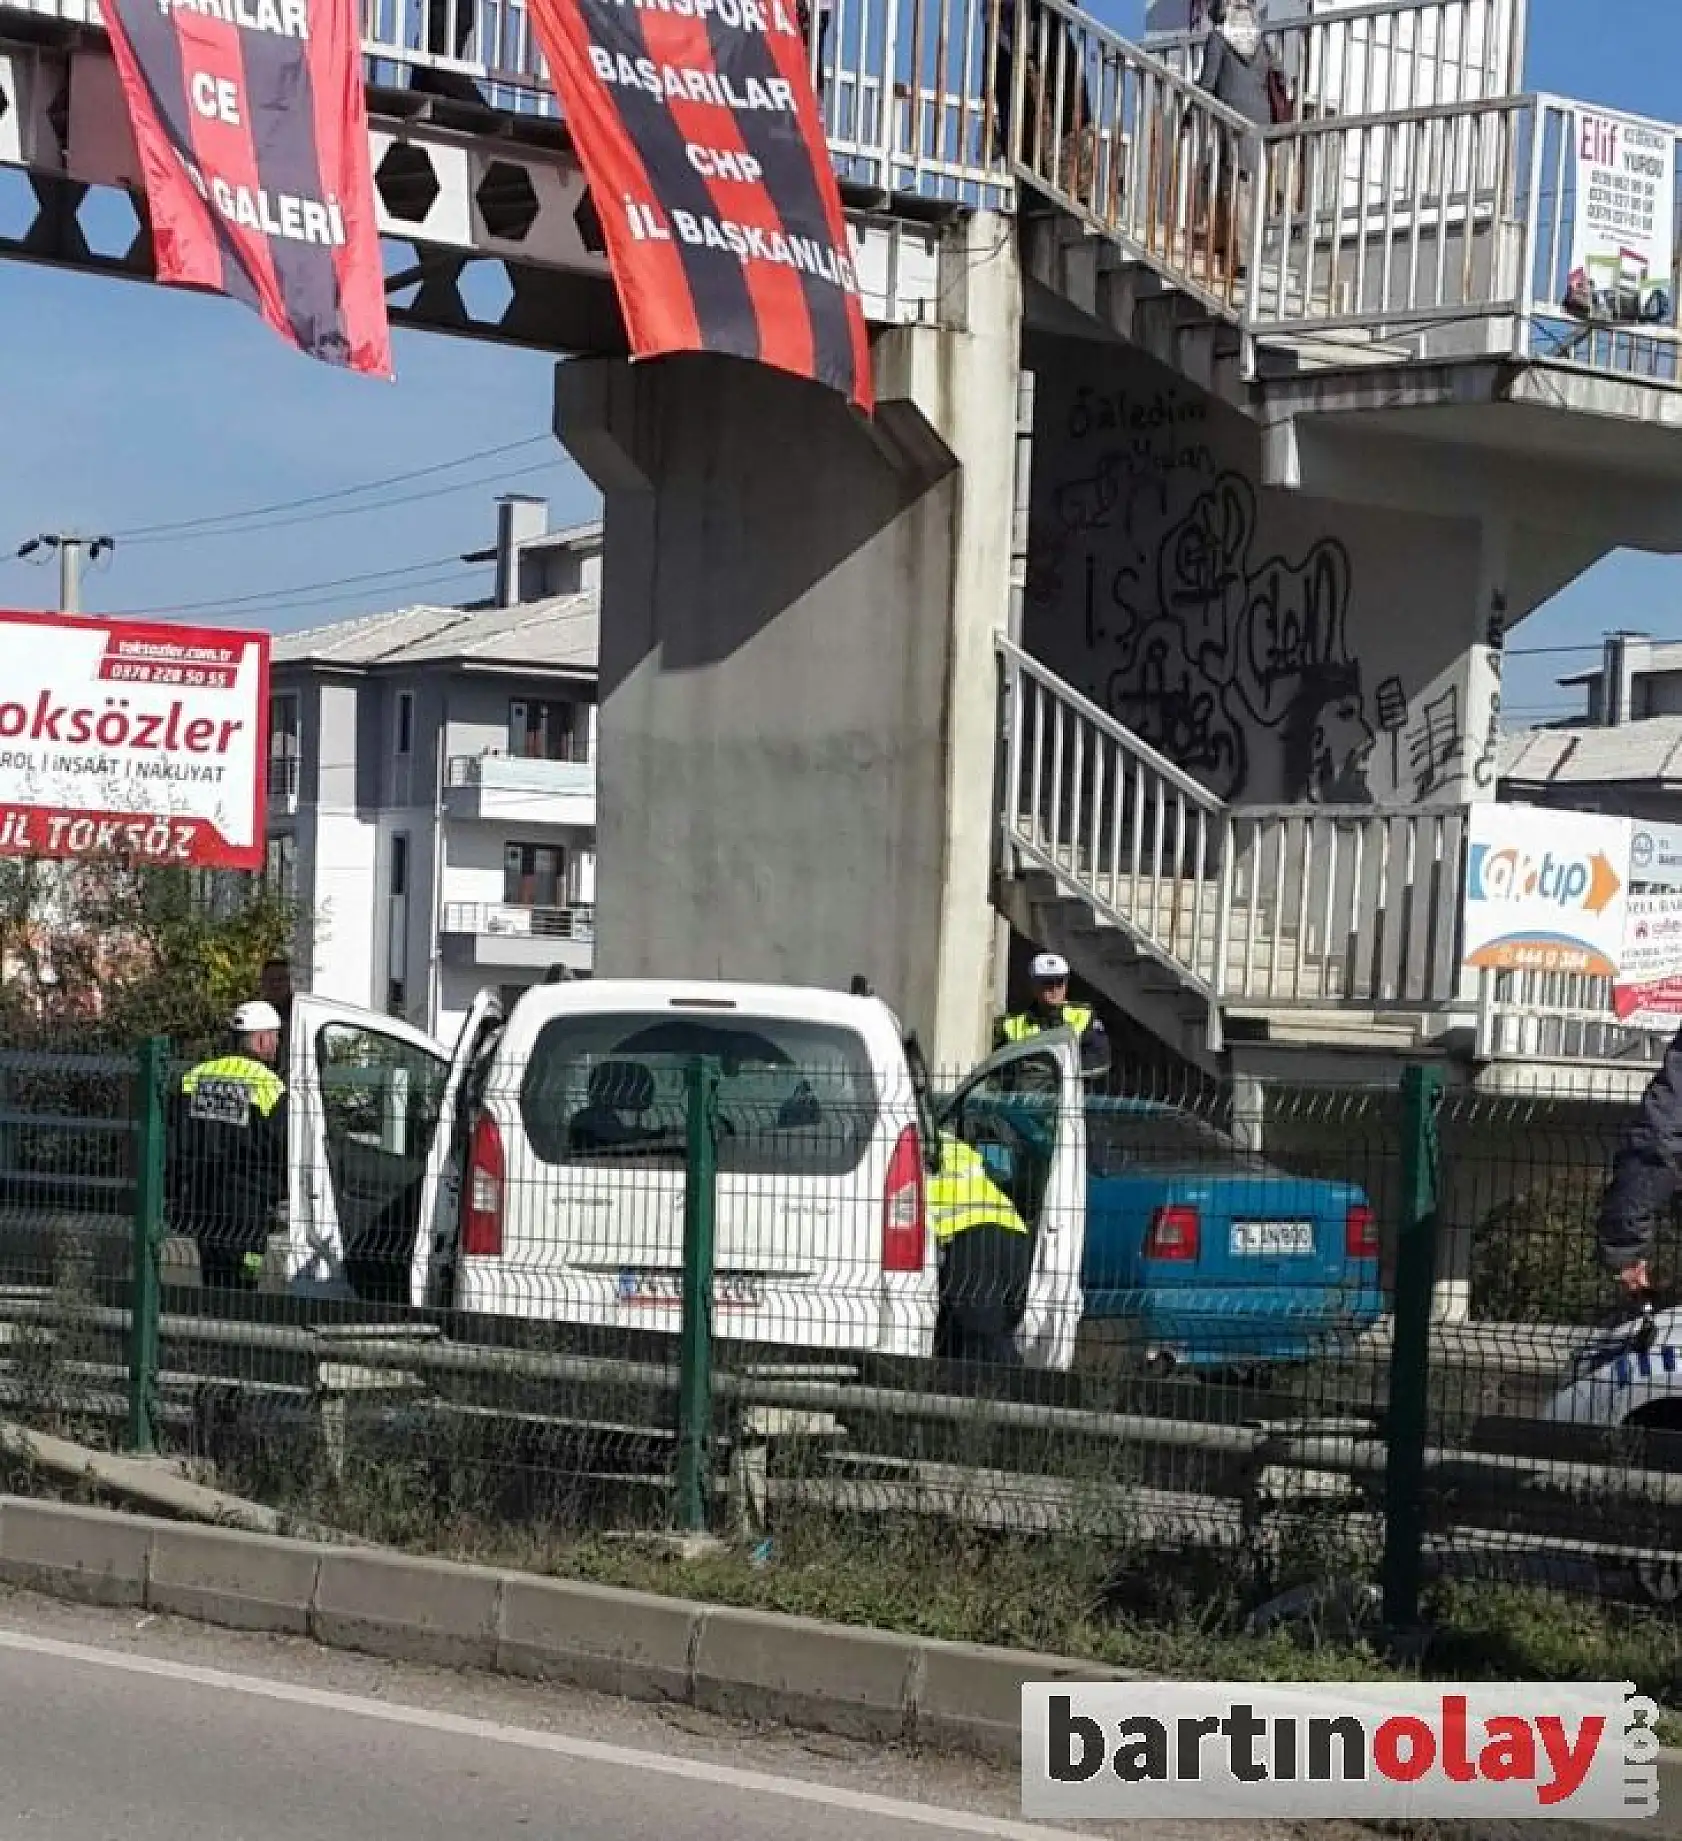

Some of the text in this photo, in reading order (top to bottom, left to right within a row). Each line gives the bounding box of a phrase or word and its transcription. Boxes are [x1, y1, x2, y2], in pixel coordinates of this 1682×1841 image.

[192, 71, 241, 125] CE
[588, 46, 797, 112] BAŞARILAR
[686, 144, 764, 183] CHP
[1580, 116, 1618, 167] Elif
[212, 176, 346, 245] GALERİ
[624, 192, 671, 240] İL
[47, 814, 198, 858] TOKSÖZ
